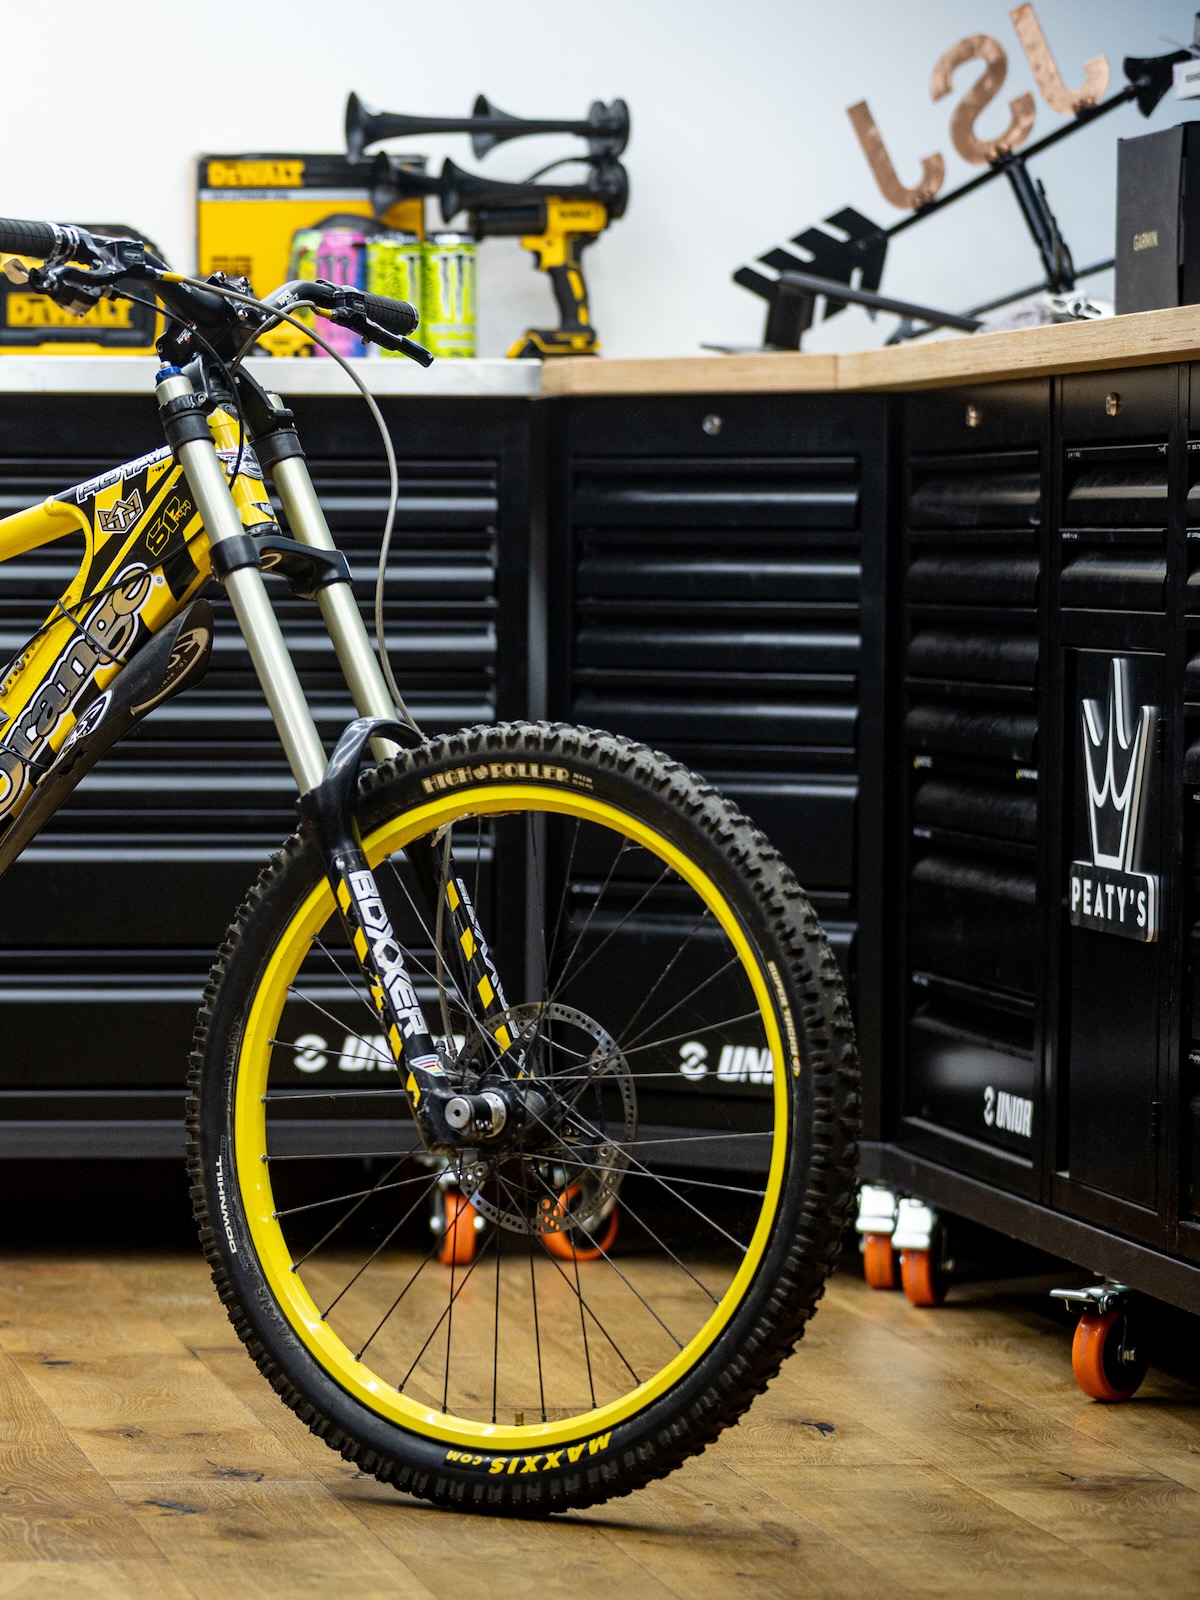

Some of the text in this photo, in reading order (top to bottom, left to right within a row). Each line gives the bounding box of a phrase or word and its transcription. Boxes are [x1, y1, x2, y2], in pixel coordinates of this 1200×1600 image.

[208, 160, 304, 187] DEWALT
[1132, 230, 1159, 251] GARMIN
[421, 766, 473, 794] HIGH
[489, 762, 570, 783] ROLLER
[1071, 876, 1146, 927] PEATY'S
[767, 961, 788, 1007] SUPER
[783, 1007, 799, 1057] TACKY
[717, 1045, 774, 1085] UNI
[995, 1091, 1033, 1138] UNIOR
[216, 1155, 237, 1253] DOWNHILL
[445, 1431, 612, 1475] MAXXIS.COM
